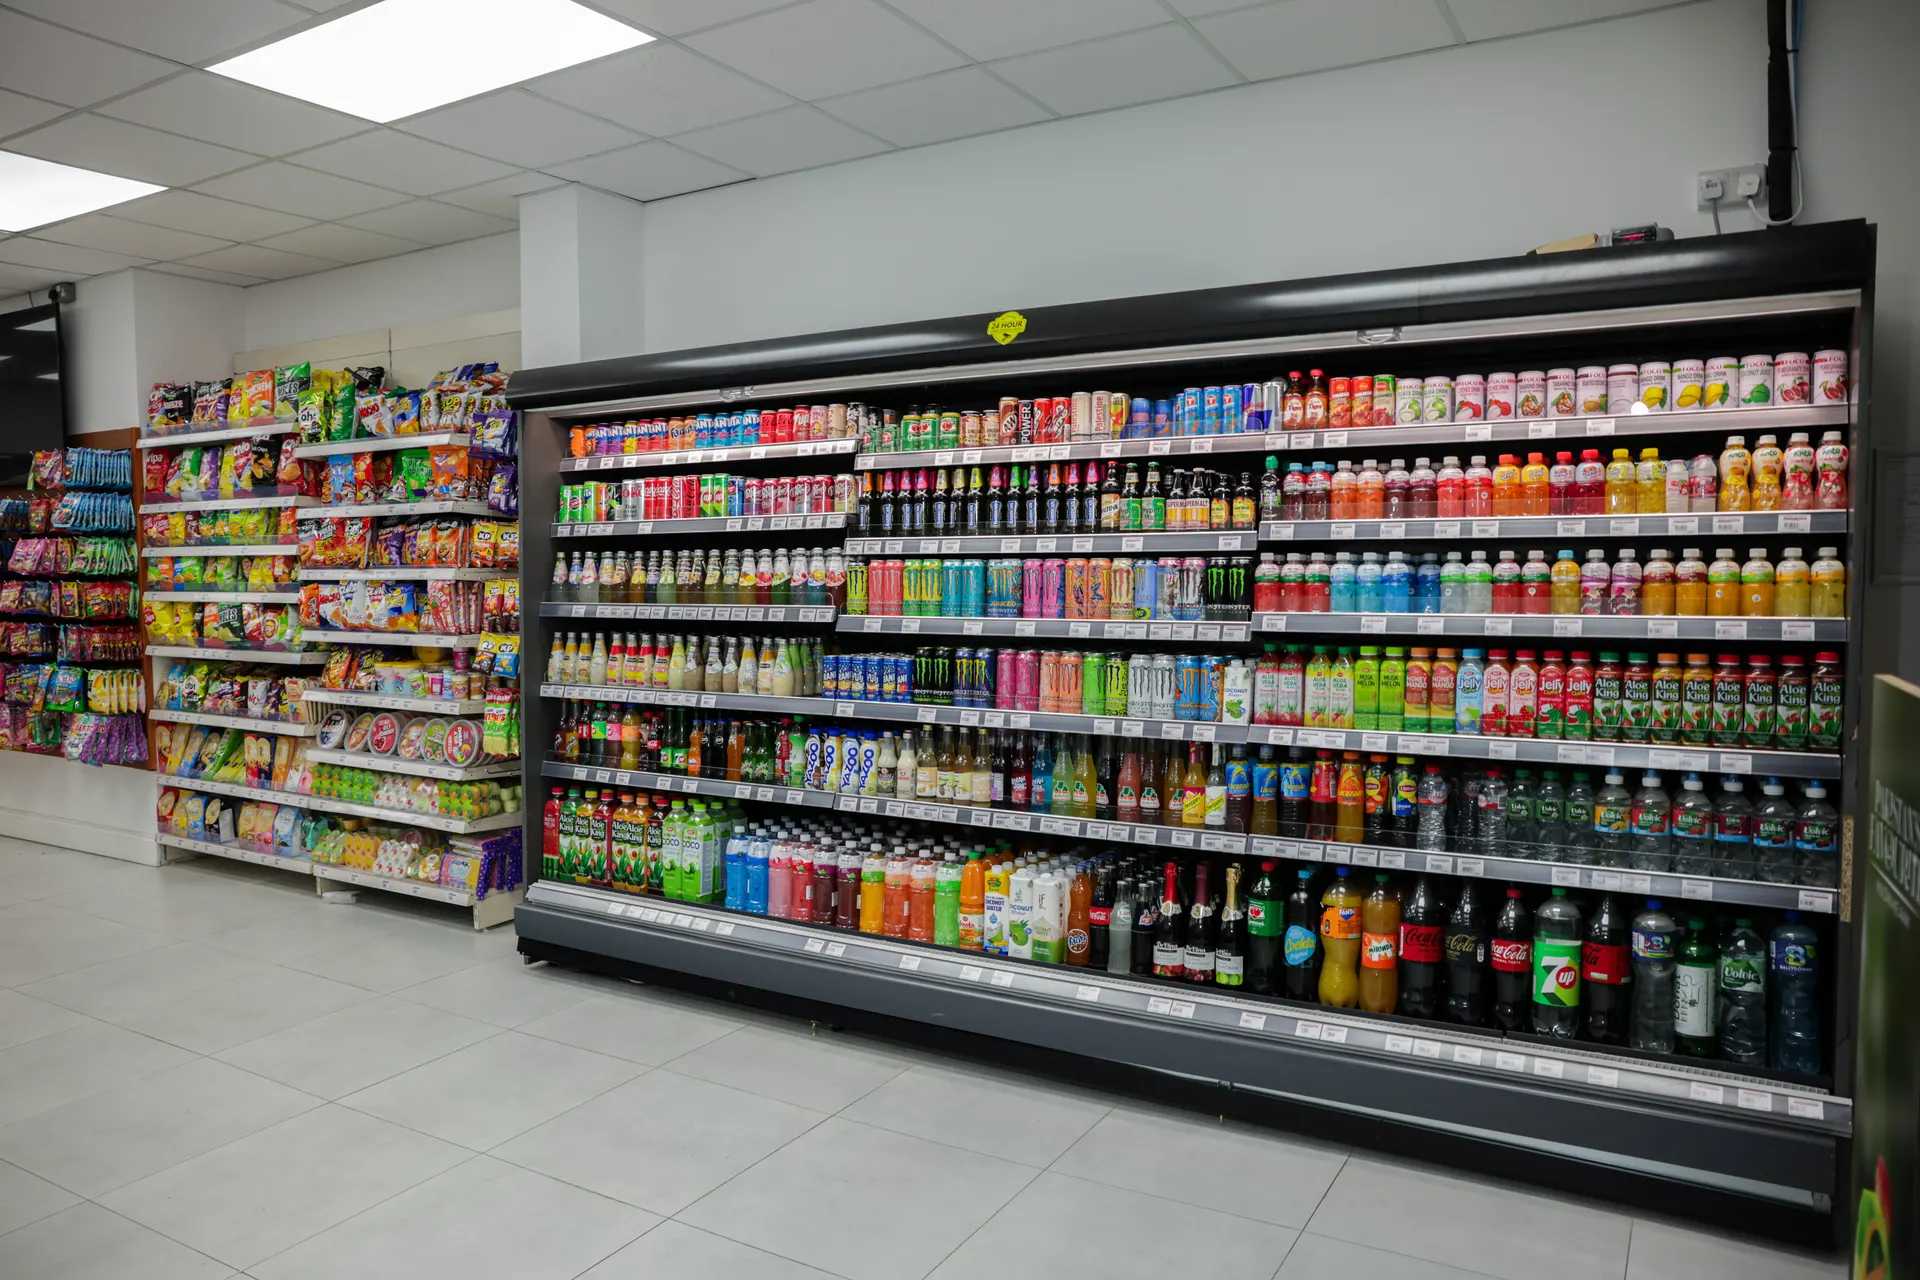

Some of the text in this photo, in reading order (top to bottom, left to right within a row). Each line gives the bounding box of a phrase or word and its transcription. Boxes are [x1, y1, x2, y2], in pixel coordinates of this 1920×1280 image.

[1001, 321, 1023, 329] HOUR
[1095, 396, 1104, 432] Palestine
[477, 531, 491, 541] KP
[499, 643, 514, 653] KP
[1458, 675, 1482, 691] jelly
[1485, 674, 1508, 691] jelly
[1511, 676, 1537, 691] jelly
[1539, 677, 1564, 693] jelly
[1566, 678, 1593, 694] jelly
[1595, 678, 1620, 688] Aloe
[1625, 680, 1649, 690] Aloe
[1655, 679, 1680, 690] Aloe
[1686, 680, 1711, 691] Aloe
[1716, 681, 1741, 692] Aloe
[1748, 682, 1773, 693] Aloe
[1814, 682, 1841, 693] Aloe
[1595, 688, 1620, 699] King
[1779, 684, 1807, 694] Aloe
[1625, 690, 1649, 700] King
[1655, 689, 1680, 701] King
[1686, 691, 1710, 701] King
[1717, 691, 1740, 702] King
[1749, 692, 1773, 703] King
[1780, 694, 1807, 705] King
[1814, 692, 1840, 703] King
[804, 742, 819, 784] YAZOO
[841, 746, 858, 788] YAZOO
[858, 748, 875, 790] YAZOO
[559, 814, 574, 823] Aloe
[575, 817, 589, 826] Aloe
[591, 819, 605, 829] Aloe
[559, 823, 574, 833] King
[575, 825, 589, 835] King
[612, 821, 628, 831] Aloe
[627, 823, 643, 833] Aloe
[648, 826, 662, 835] Aloe
[591, 828, 605, 838] King
[612, 830, 628, 839] King
[626, 832, 643, 842] King
[647, 834, 662, 845] King
[662, 837, 680, 846] COCO
[1724, 966, 1758, 981] Volvic
